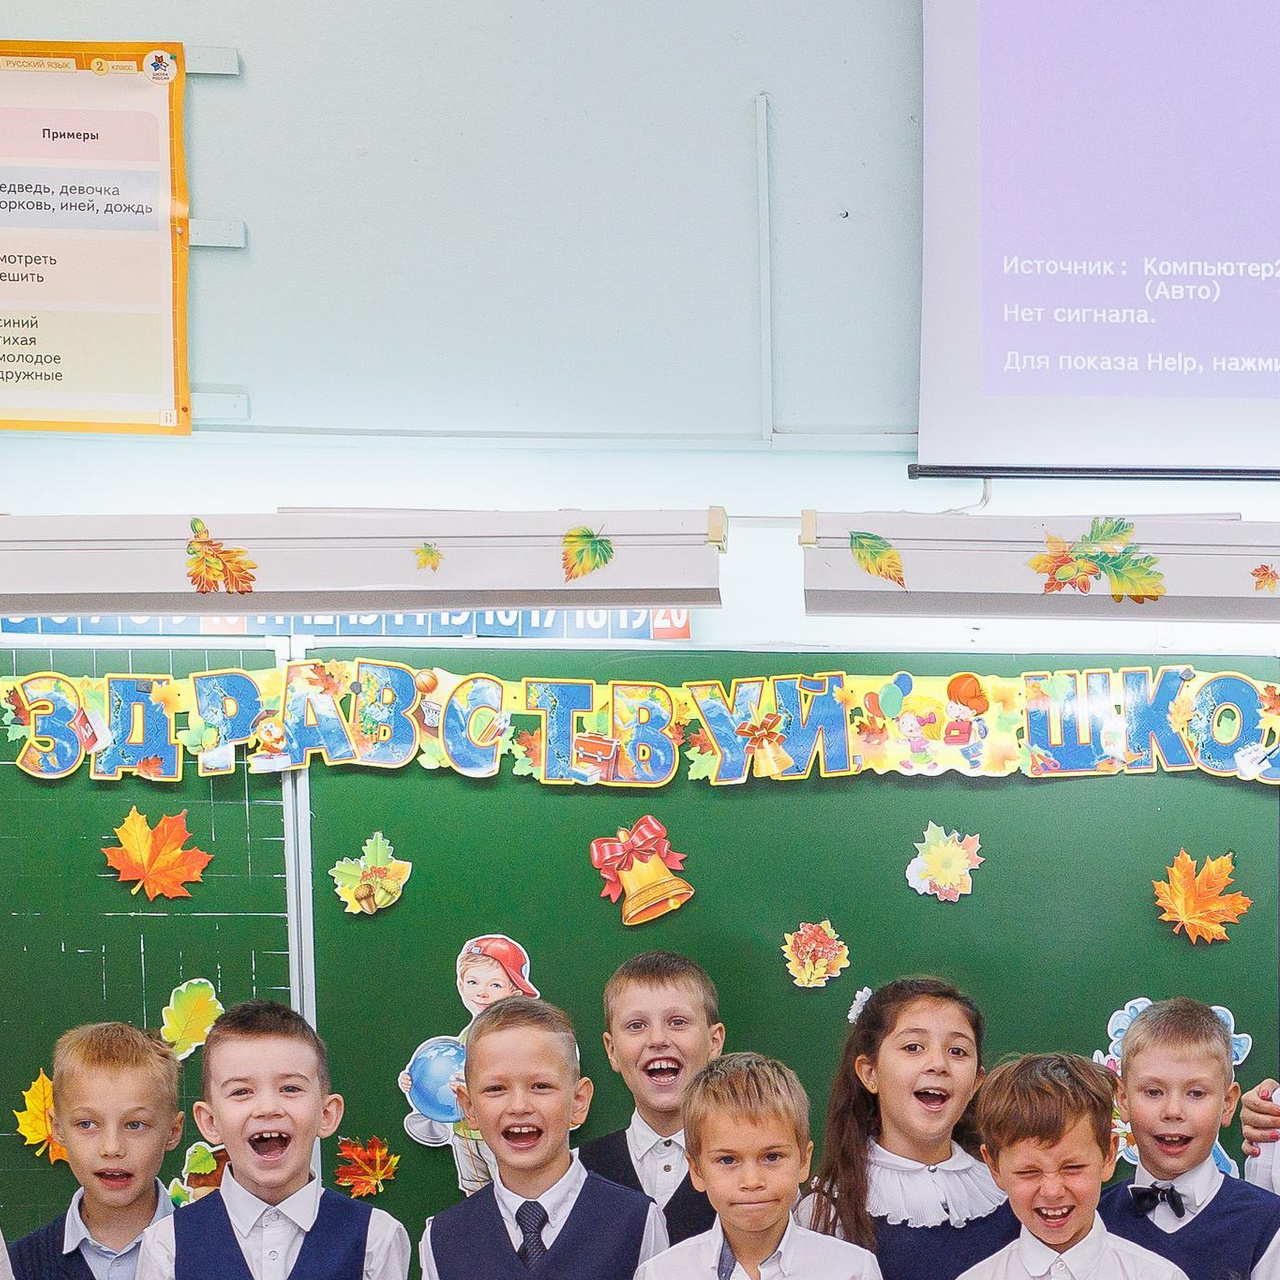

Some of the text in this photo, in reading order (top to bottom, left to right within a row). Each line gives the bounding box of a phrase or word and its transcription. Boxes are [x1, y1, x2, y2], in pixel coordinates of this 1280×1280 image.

[6, 59, 71, 70] РУССКИЙ ЯЗЫК
[96, 61, 104, 71] 2
[42, 128, 99, 142] Примеры
[0, 183, 120, 196] едведь, девочка
[0, 200, 153, 214] орковь, иней, дождь
[0, 254, 57, 267] мотреть
[0, 272, 44, 282] ешить
[1145, 280, 1221, 303] (Авто)
[1003, 304, 1158, 325] Нет сигнала.
[1003, 351, 1050, 372] Для
[1058, 353, 1140, 372] показа
[1147, 352, 1205, 377] Help,
